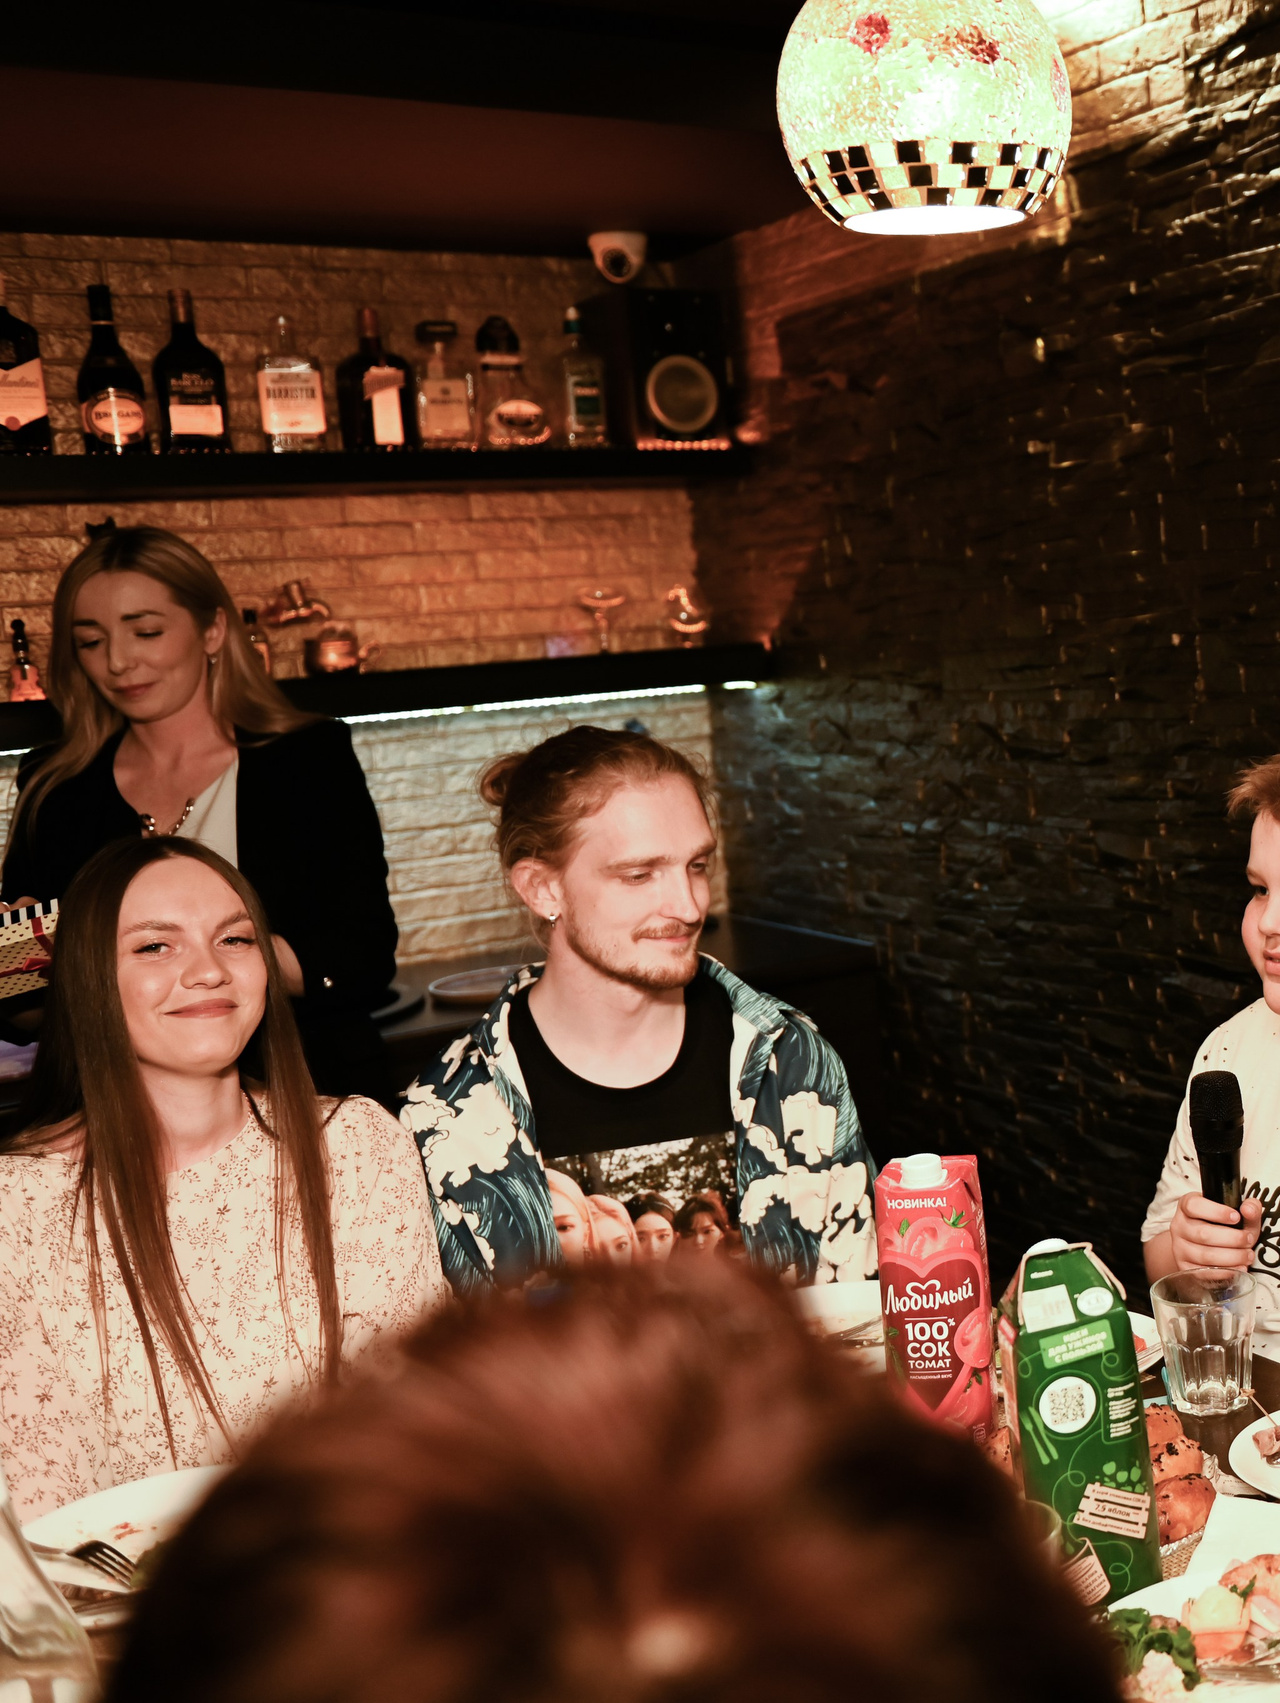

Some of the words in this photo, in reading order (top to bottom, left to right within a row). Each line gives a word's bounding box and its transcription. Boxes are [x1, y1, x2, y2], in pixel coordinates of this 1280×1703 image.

[887, 1197, 947, 1210] НОВИНКА!
[885, 1277, 974, 1315] Любимый
[904, 1317, 956, 1341] 100%
[906, 1340, 951, 1358] СОК
[908, 1358, 952, 1369] ТОМАТ
[1107, 1506, 1131, 1517] яблок
